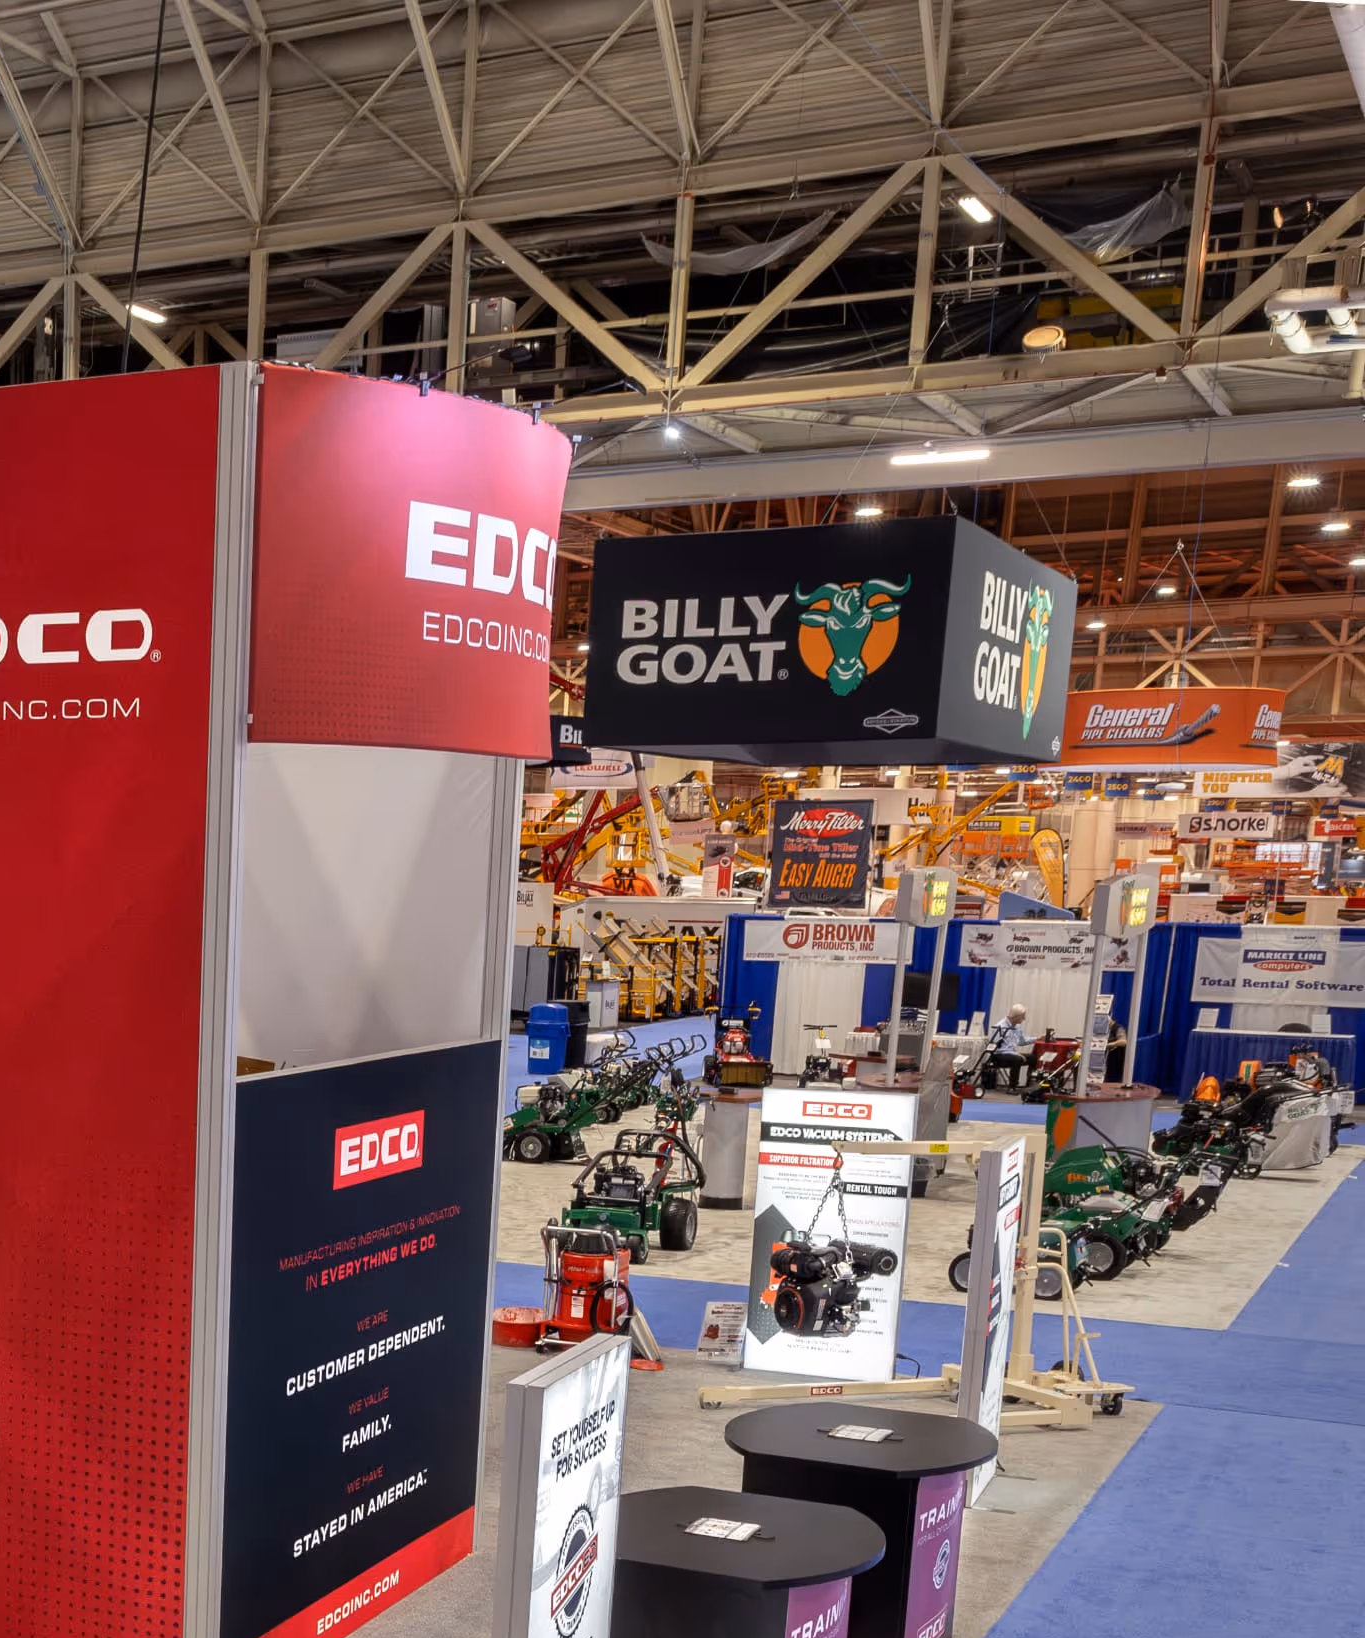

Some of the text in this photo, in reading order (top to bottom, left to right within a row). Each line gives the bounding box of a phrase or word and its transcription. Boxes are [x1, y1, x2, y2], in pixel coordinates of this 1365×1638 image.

[620, 592, 790, 641] BILLY
[980, 570, 1031, 643] BILLY
[615, 641, 787, 687] GOAT
[972, 640, 1022, 711] GOAT
[1085, 703, 1176, 731] General
[1081, 724, 1166, 741] PIPE CLEANERS
[1202, 784, 1229, 793] YOU
[780, 811, 865, 835] Merry Tiller
[1203, 816, 1269, 832] snorkel
[779, 858, 857, 888] EASY AUGER
[812, 941, 875, 952] PRODUCTS, INC
[813, 924, 876, 942] BROWN
[1014, 944, 1041, 953] BROWN
[1246, 951, 1324, 961] MARKET LINE
[1256, 962, 1311, 972] computers
[1200, 976, 1364, 991] Total Rental Software
[806, 1103, 869, 1118] EDCO
[770, 1126, 800, 1139] EDCO
[802, 1128, 844, 1140] VACUUM
[340, 1123, 419, 1176] EDCO
[769, 1154, 798, 1165] SUPERIOR
[846, 1184, 897, 1196] RENTAL TOUGH
[279, 1237, 356, 1271] MANUFACTURING
[306, 1273, 318, 1291] IN
[321, 1247, 398, 1286] EVERYTHING
[400, 1240, 417, 1259] WE
[286, 1315, 446, 1397] CUSTOMER DEPENDENT.
[342, 1414, 392, 1453] FAMILY.
[551, 1400, 615, 1459] SET YOURSELF UP
[556, 1431, 608, 1483] FOR SUCCESS
[293, 1514, 347, 1558] STAYED
[350, 1503, 364, 1526] IN
[317, 1569, 400, 1635] EDCOINC.COM
